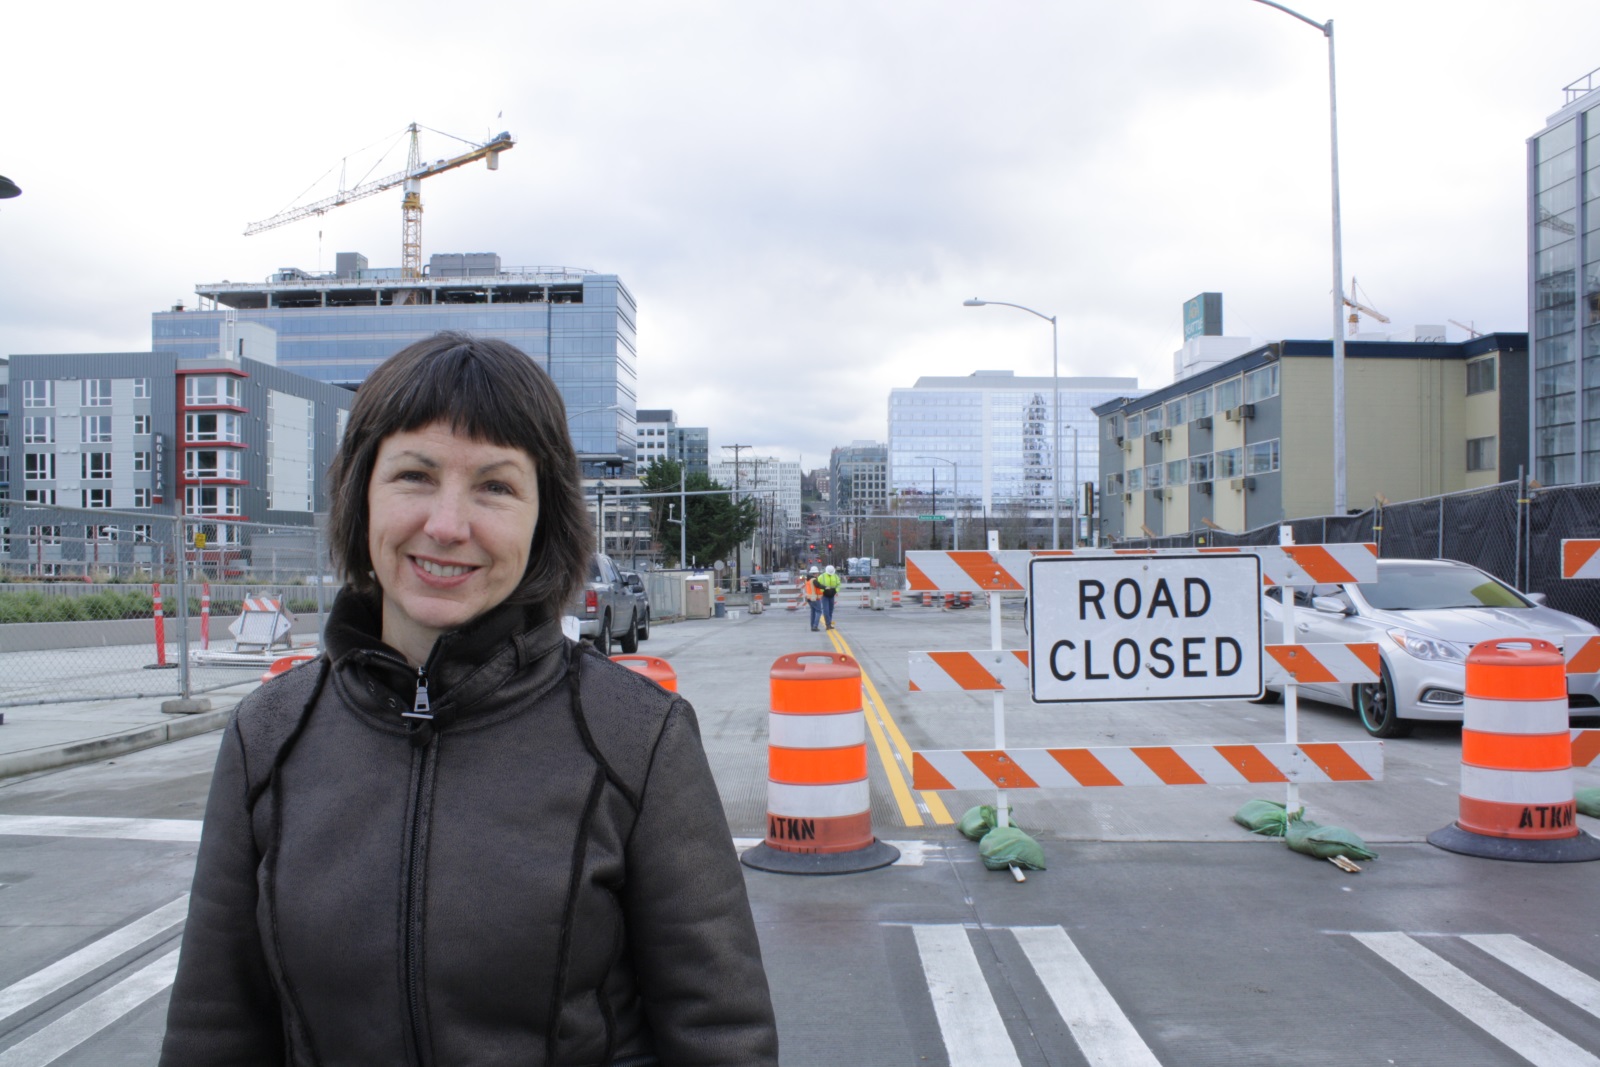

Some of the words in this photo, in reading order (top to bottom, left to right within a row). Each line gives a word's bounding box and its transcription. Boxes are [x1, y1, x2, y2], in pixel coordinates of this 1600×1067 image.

[1078, 577, 1211, 620] ROAD
[1049, 636, 1243, 681] CLOSED
[769, 817, 815, 841] ATKN
[1519, 805, 1572, 828] ATKN
